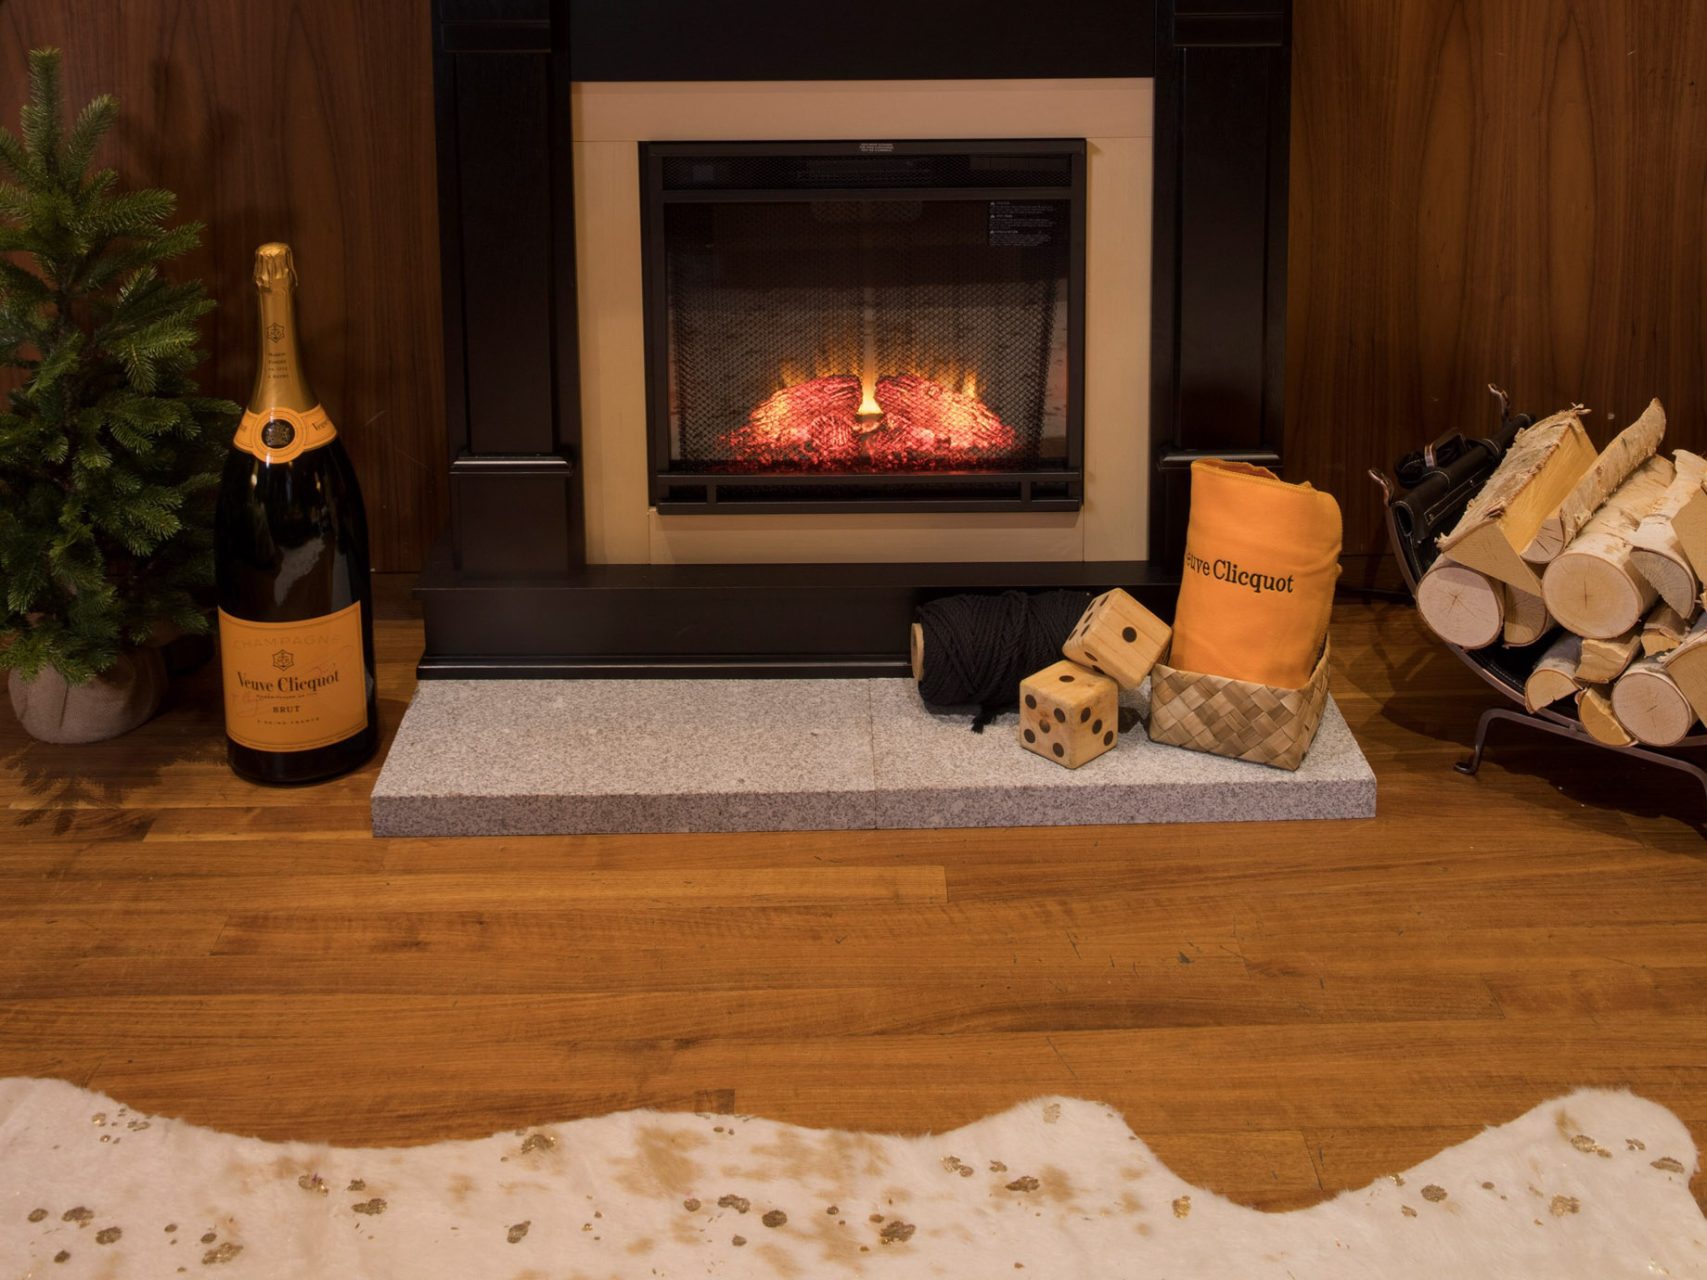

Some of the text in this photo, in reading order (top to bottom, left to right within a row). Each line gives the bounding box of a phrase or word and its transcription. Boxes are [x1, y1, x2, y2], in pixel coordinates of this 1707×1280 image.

[1187, 552, 1295, 593] euve Clicquot
[237, 670, 340, 692] Veuve Clicquot
[272, 705, 302, 713] BRUT
